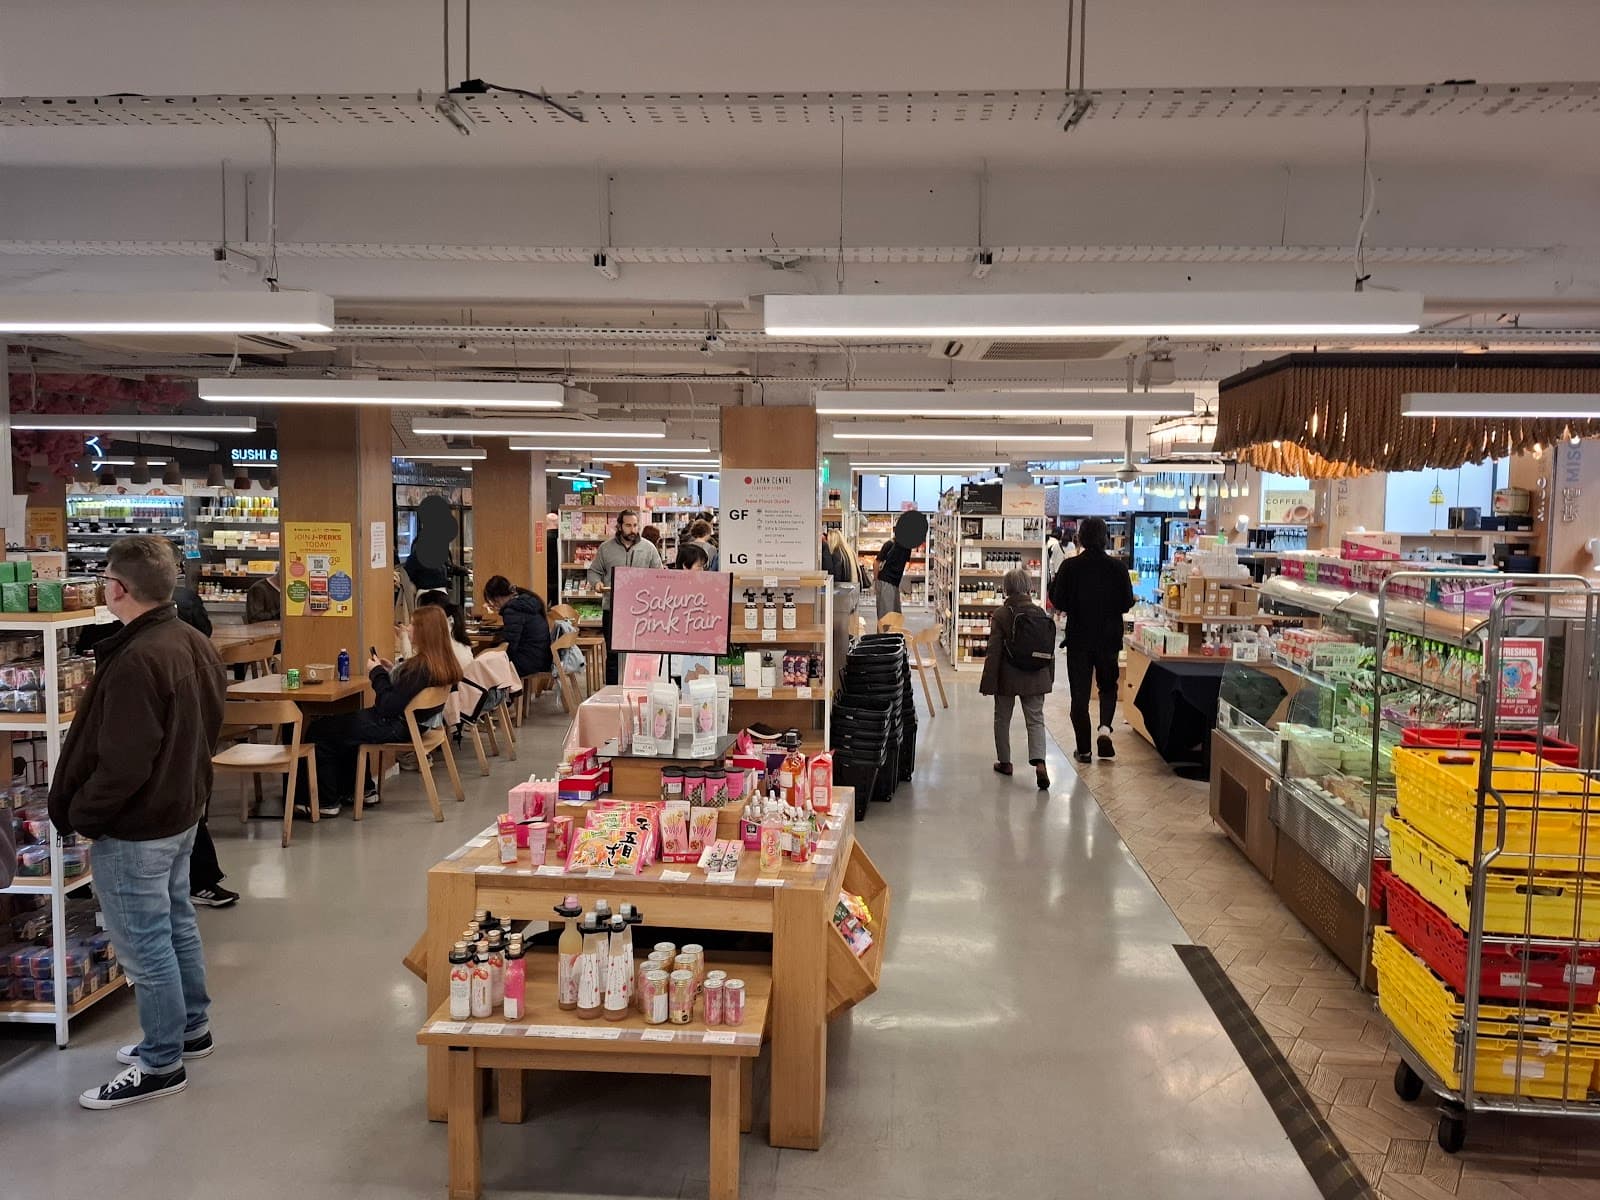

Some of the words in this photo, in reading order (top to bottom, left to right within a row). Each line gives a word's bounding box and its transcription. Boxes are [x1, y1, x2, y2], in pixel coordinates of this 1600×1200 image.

[231, 449, 266, 460] SUSHI
[270, 449, 278, 460] &
[753, 476, 770, 485] JAPAN
[771, 476, 792, 485] CENTRE
[729, 509, 749, 520] GF
[729, 553, 748, 565] LG
[630, 585, 708, 616] Sakura
[632, 609, 680, 649] pink
[683, 607, 723, 635] Fair
